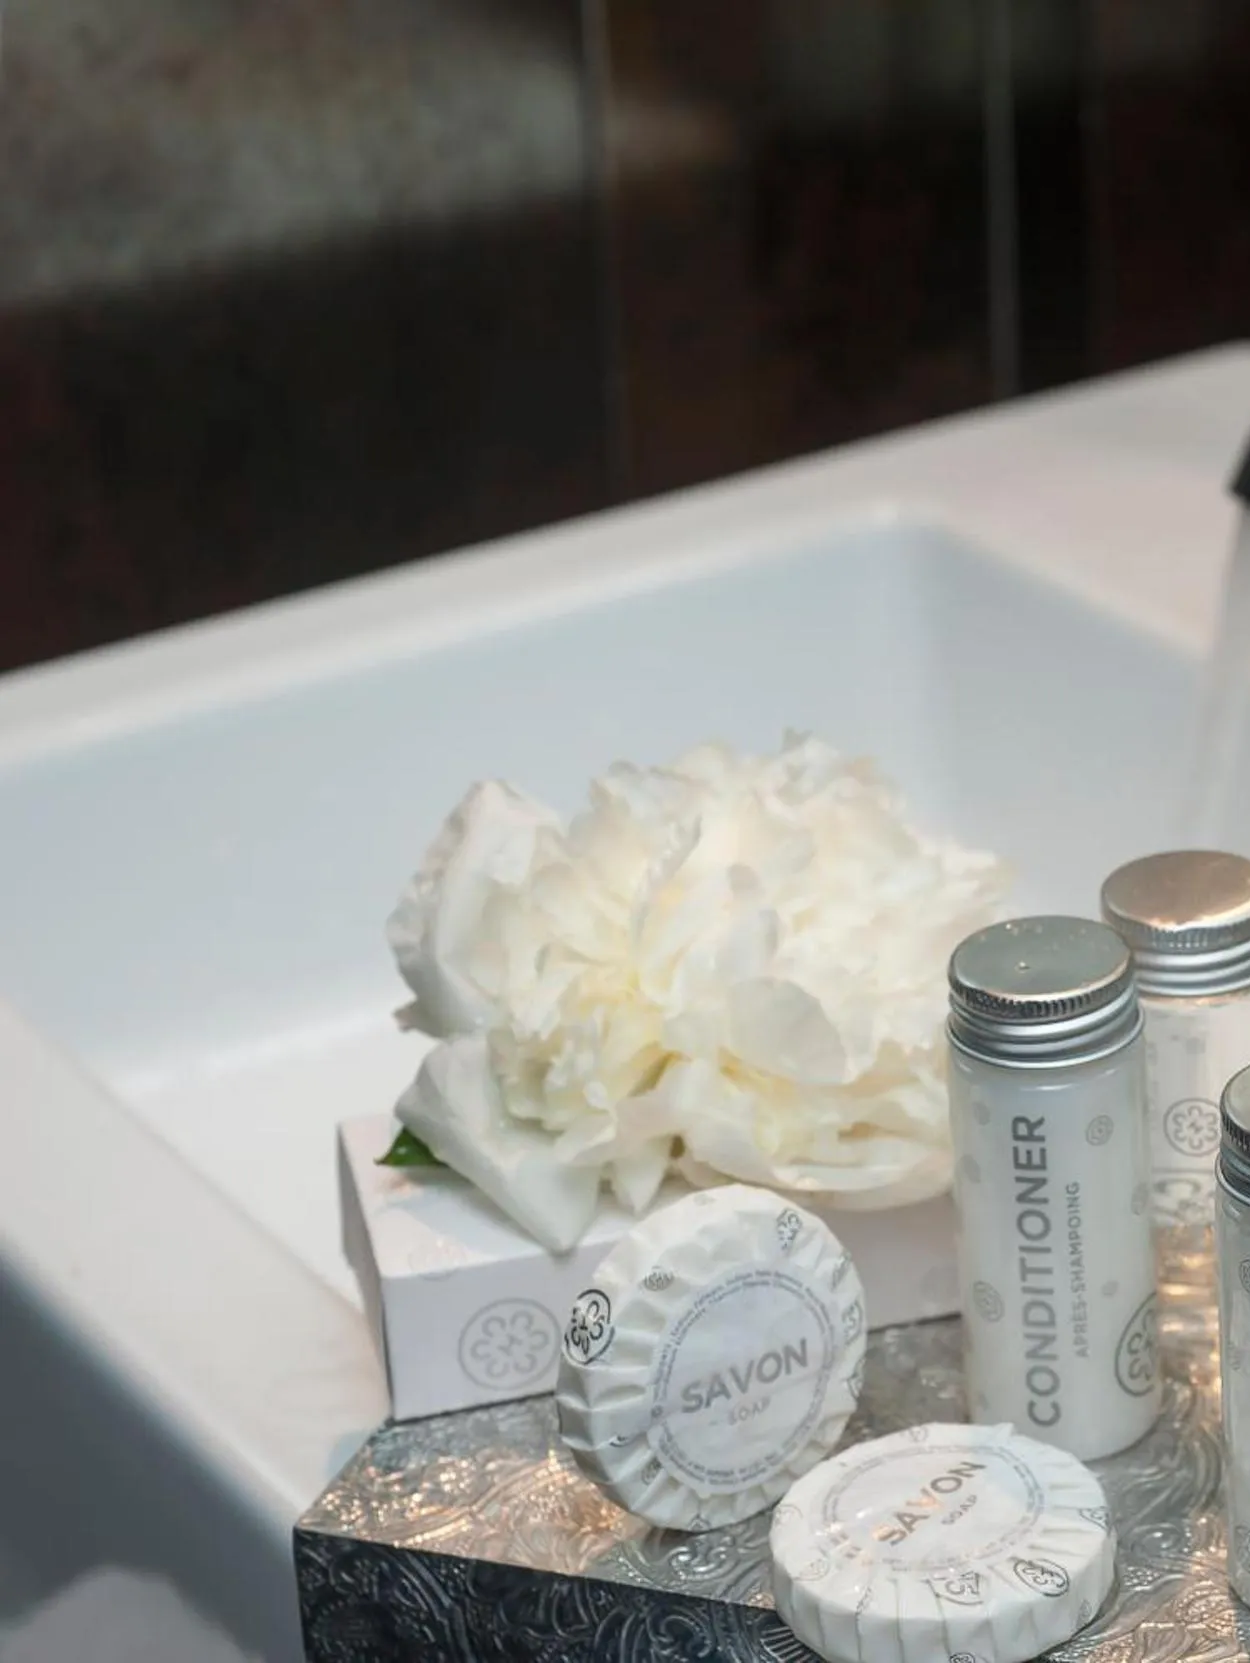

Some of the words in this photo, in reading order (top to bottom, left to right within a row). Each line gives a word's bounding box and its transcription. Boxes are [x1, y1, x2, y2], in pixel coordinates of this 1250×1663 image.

[1011, 1114, 1062, 1428] CONDITIONER
[681, 1337, 808, 1414] SAVON
[877, 1461, 987, 1547] SAVON
[940, 1494, 977, 1525] SOAP
